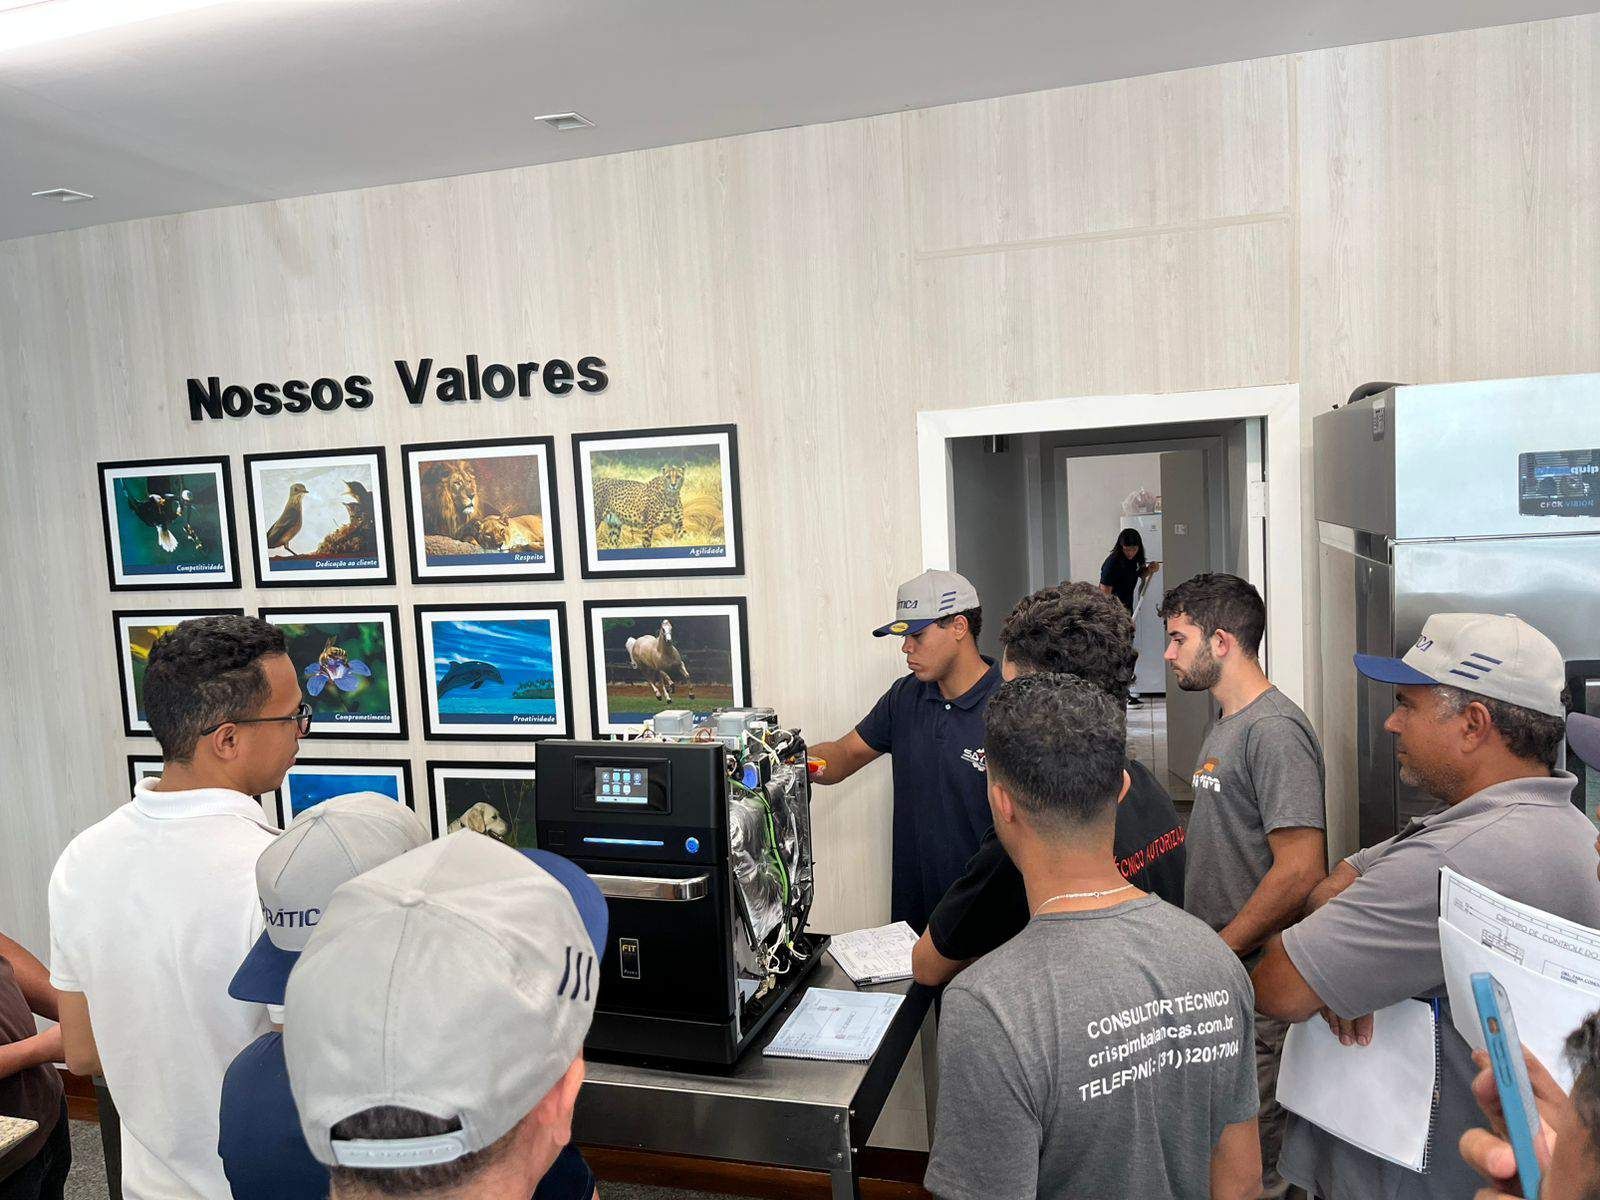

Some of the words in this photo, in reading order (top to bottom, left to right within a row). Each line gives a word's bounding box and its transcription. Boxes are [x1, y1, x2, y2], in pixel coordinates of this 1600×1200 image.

[187, 375, 374, 421] Nossos
[394, 354, 609, 405] Valores
[689, 547, 724, 557] Agilidade
[514, 553, 544, 562] Respeito
[176, 564, 224, 573] Competitividade
[315, 560, 346, 569] Dedicação
[357, 559, 378, 567] cliente
[335, 713, 391, 722] Comprometimento
[512, 714, 556, 723] Proatividade
[622, 944, 637, 952] FIT
[1087, 999, 1174, 1039] CONSULTOR
[1174, 990, 1230, 1014] TÉCNICO
